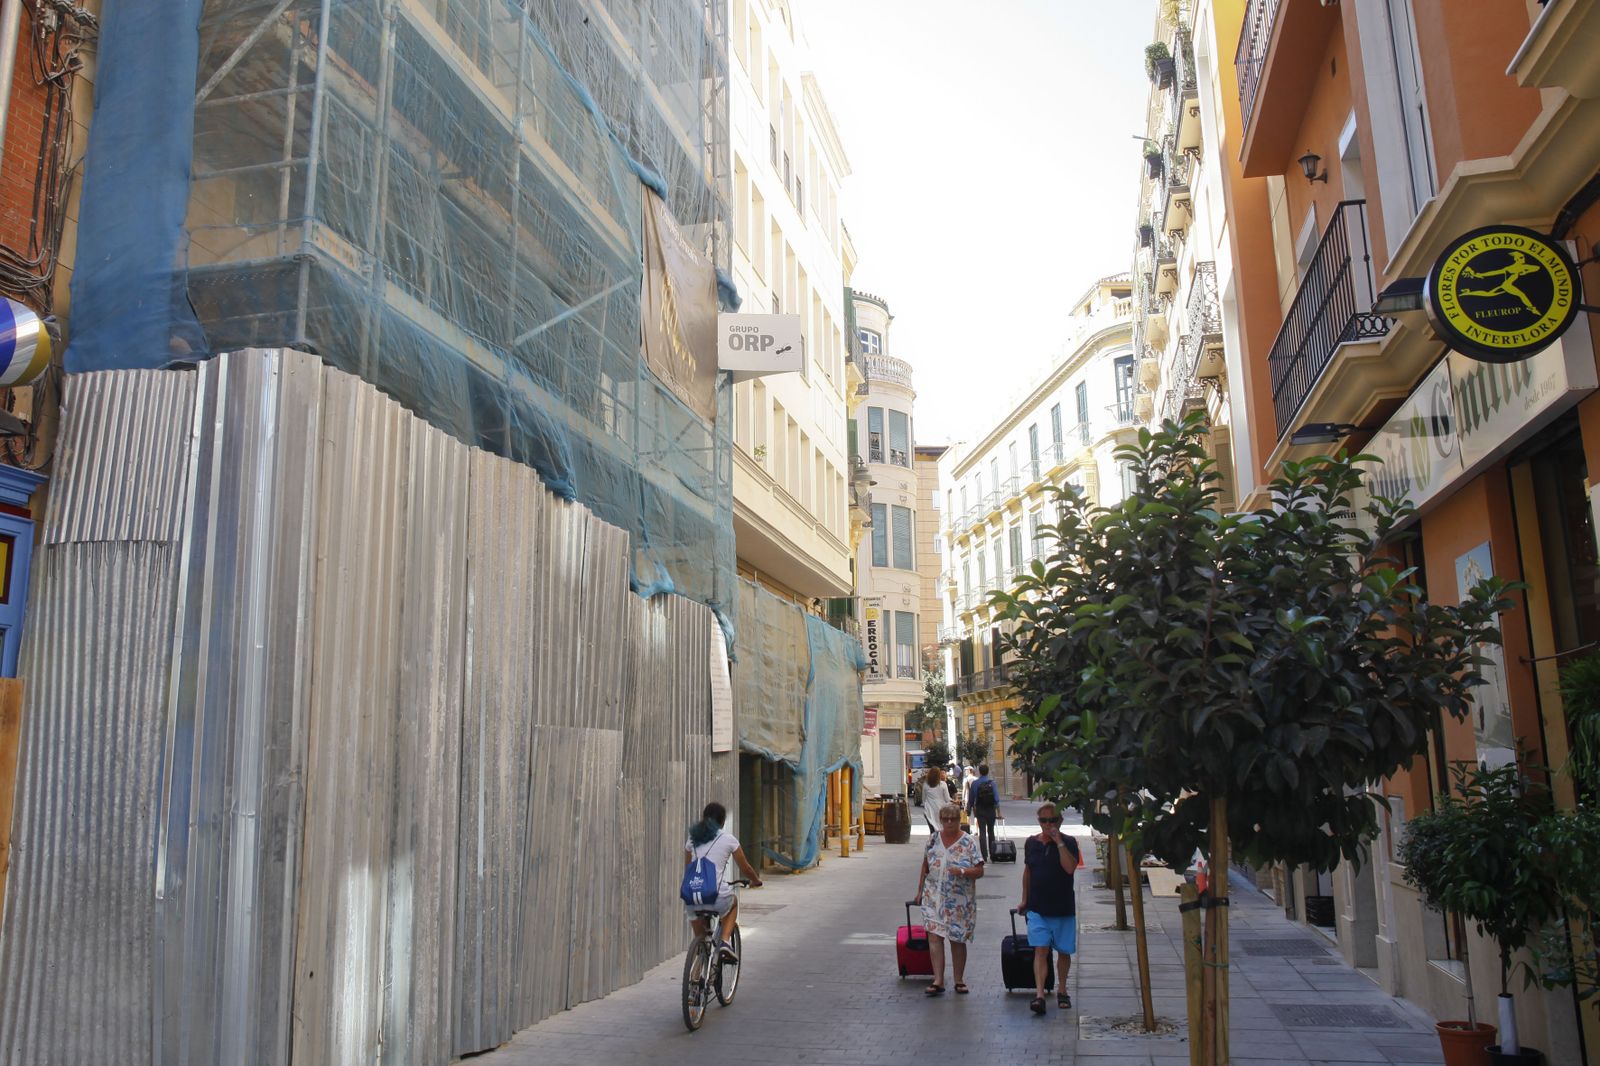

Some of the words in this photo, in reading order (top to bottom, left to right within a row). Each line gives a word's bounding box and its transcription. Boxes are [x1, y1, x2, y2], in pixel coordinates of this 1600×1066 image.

[1441, 267, 1460, 319] FLORES
[1453, 243, 1479, 264] POR
[1481, 236, 1525, 249] TODO
[1529, 243, 1545, 258] EL
[1547, 257, 1569, 307] MUNDO
[1475, 306, 1521, 318] FLEUROP
[729, 325, 759, 333] GRUPO
[1465, 317, 1557, 344] INTERFLORA
[728, 333, 775, 351] ORP
[866, 608, 879, 673] BERROCAL
